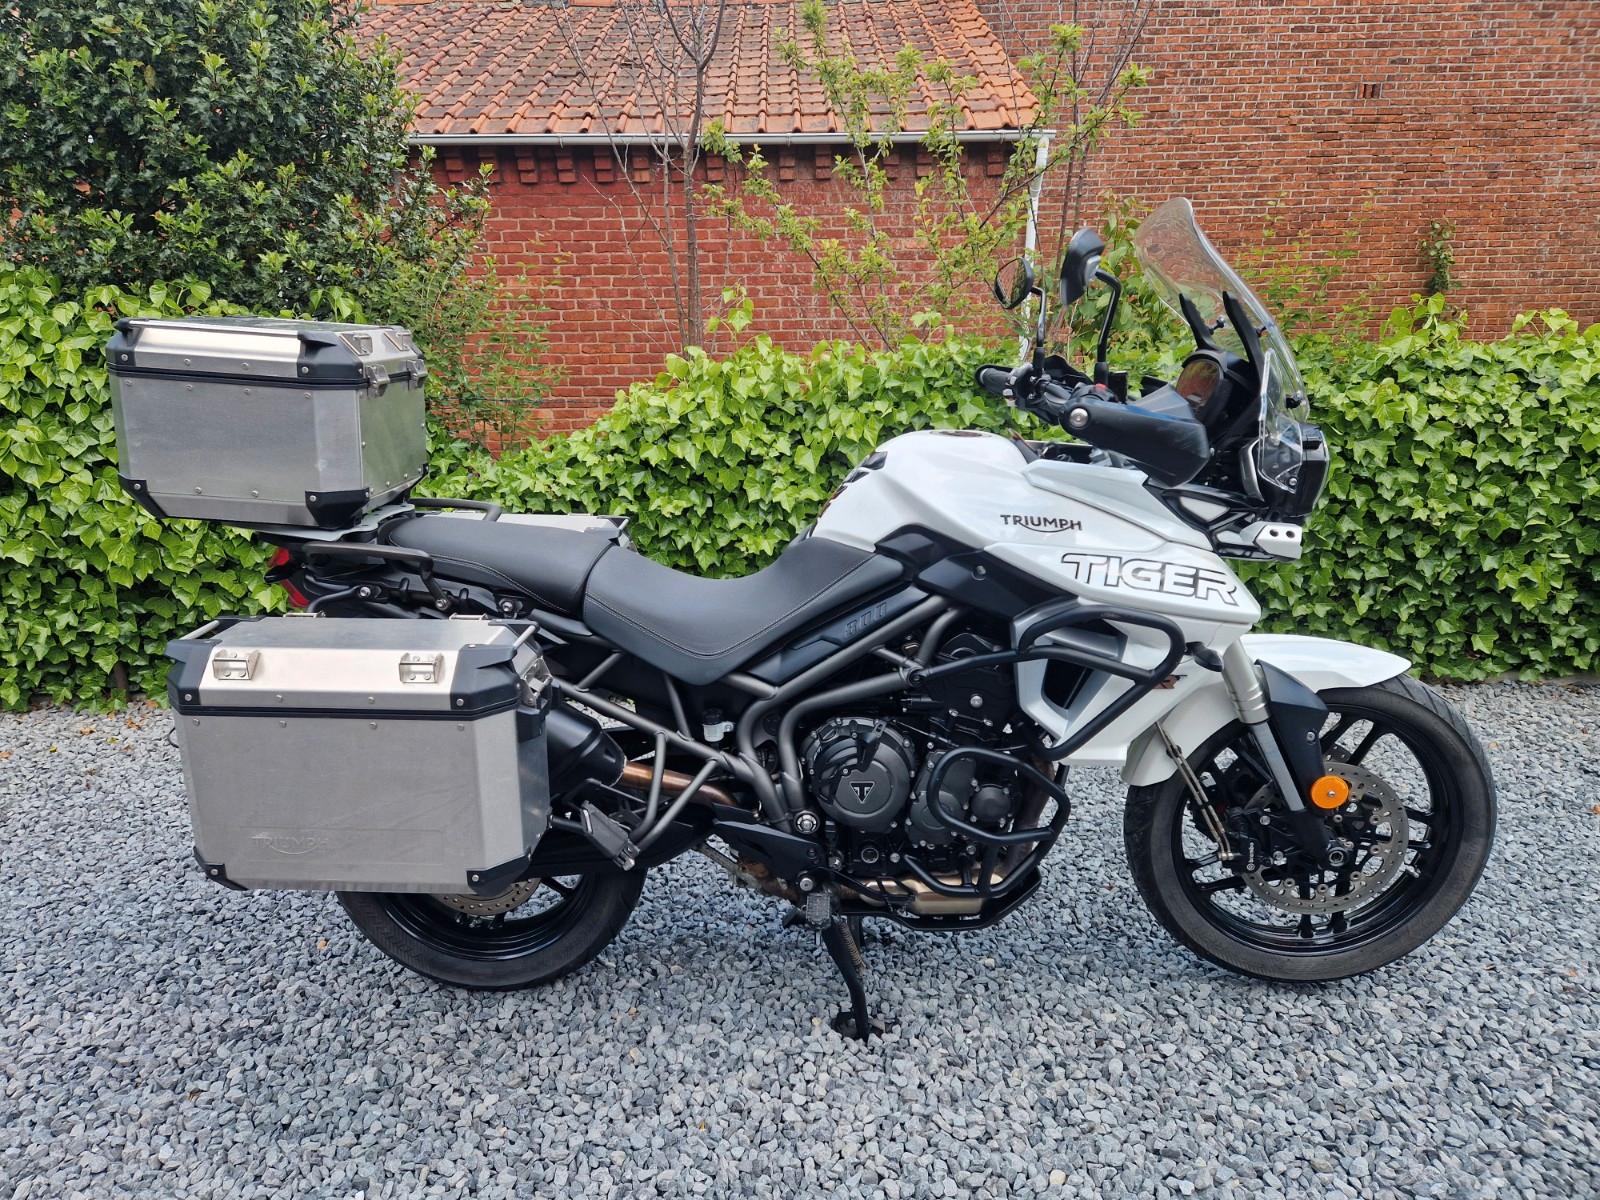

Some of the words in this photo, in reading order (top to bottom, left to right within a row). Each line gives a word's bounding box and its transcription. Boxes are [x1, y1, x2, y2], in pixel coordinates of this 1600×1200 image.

[1000, 514, 1082, 533] TRIUMPH
[1061, 552, 1239, 607] TIGER
[250, 834, 329, 855] TRIUMPH
